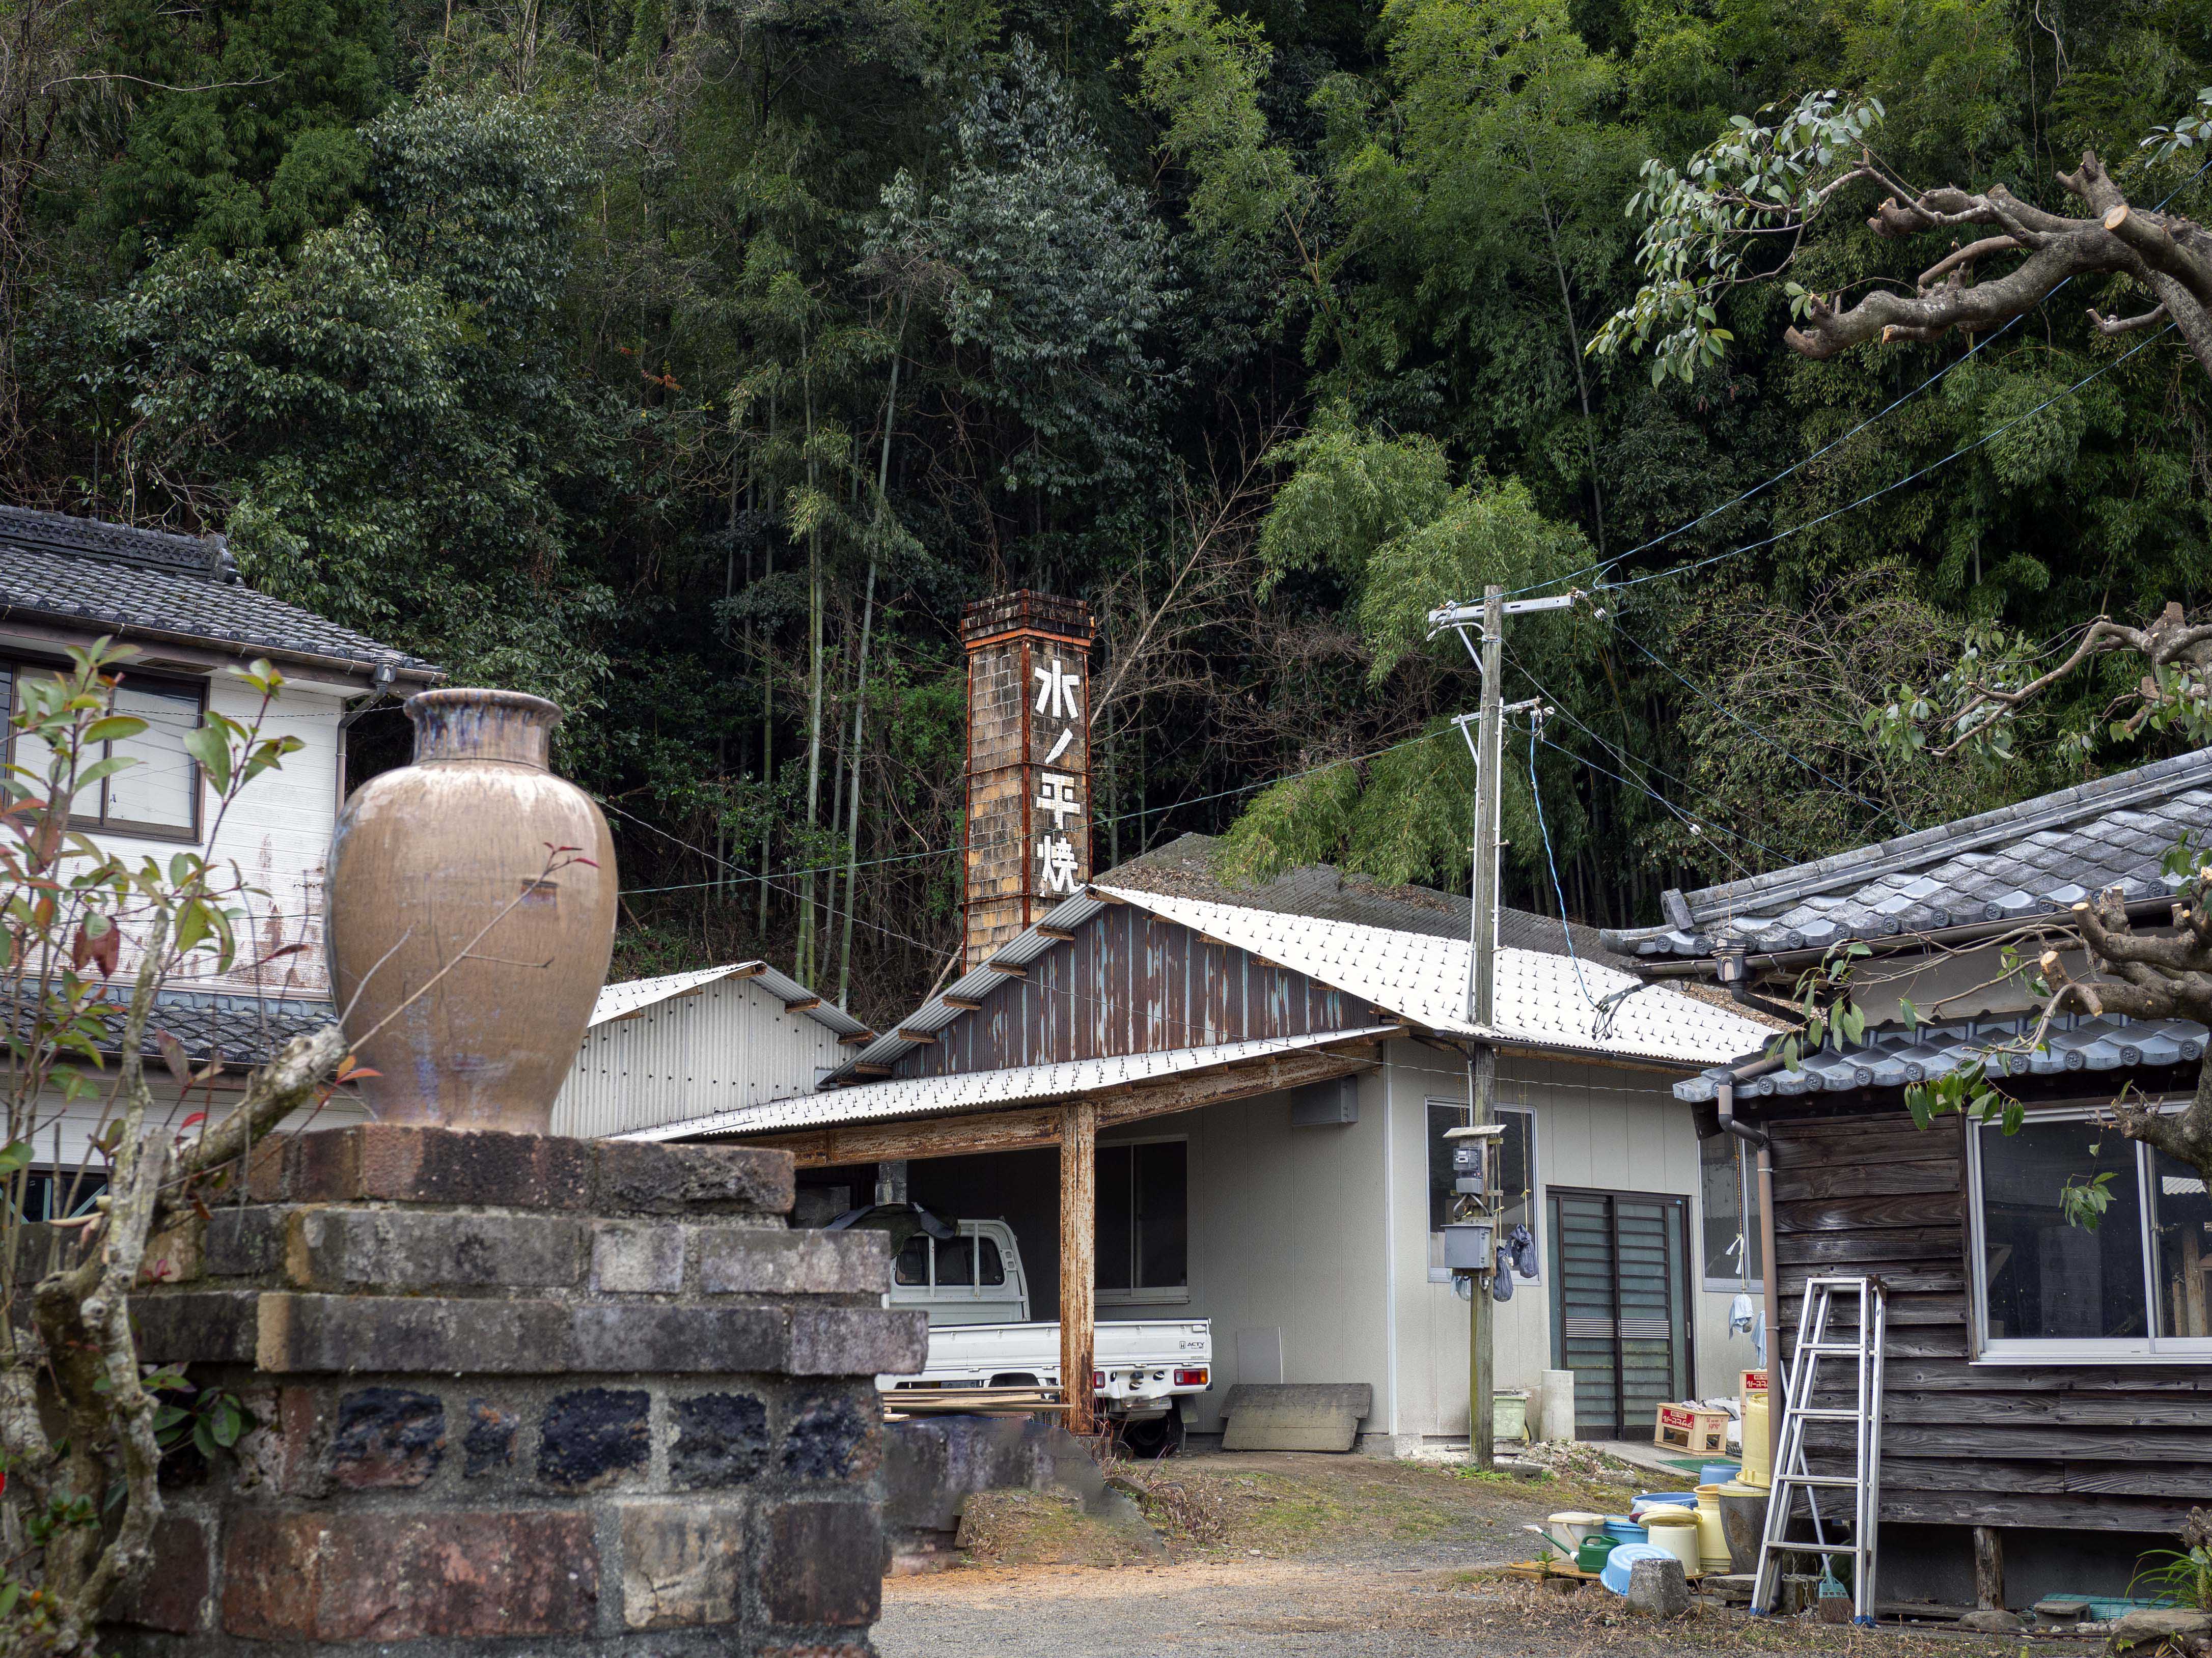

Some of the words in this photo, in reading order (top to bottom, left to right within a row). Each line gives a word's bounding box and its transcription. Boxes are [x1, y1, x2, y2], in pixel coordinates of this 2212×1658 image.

[1034, 660, 1085, 897] 水ノ平焼
[1663, 1415, 1693, 1429] アサヒビール
